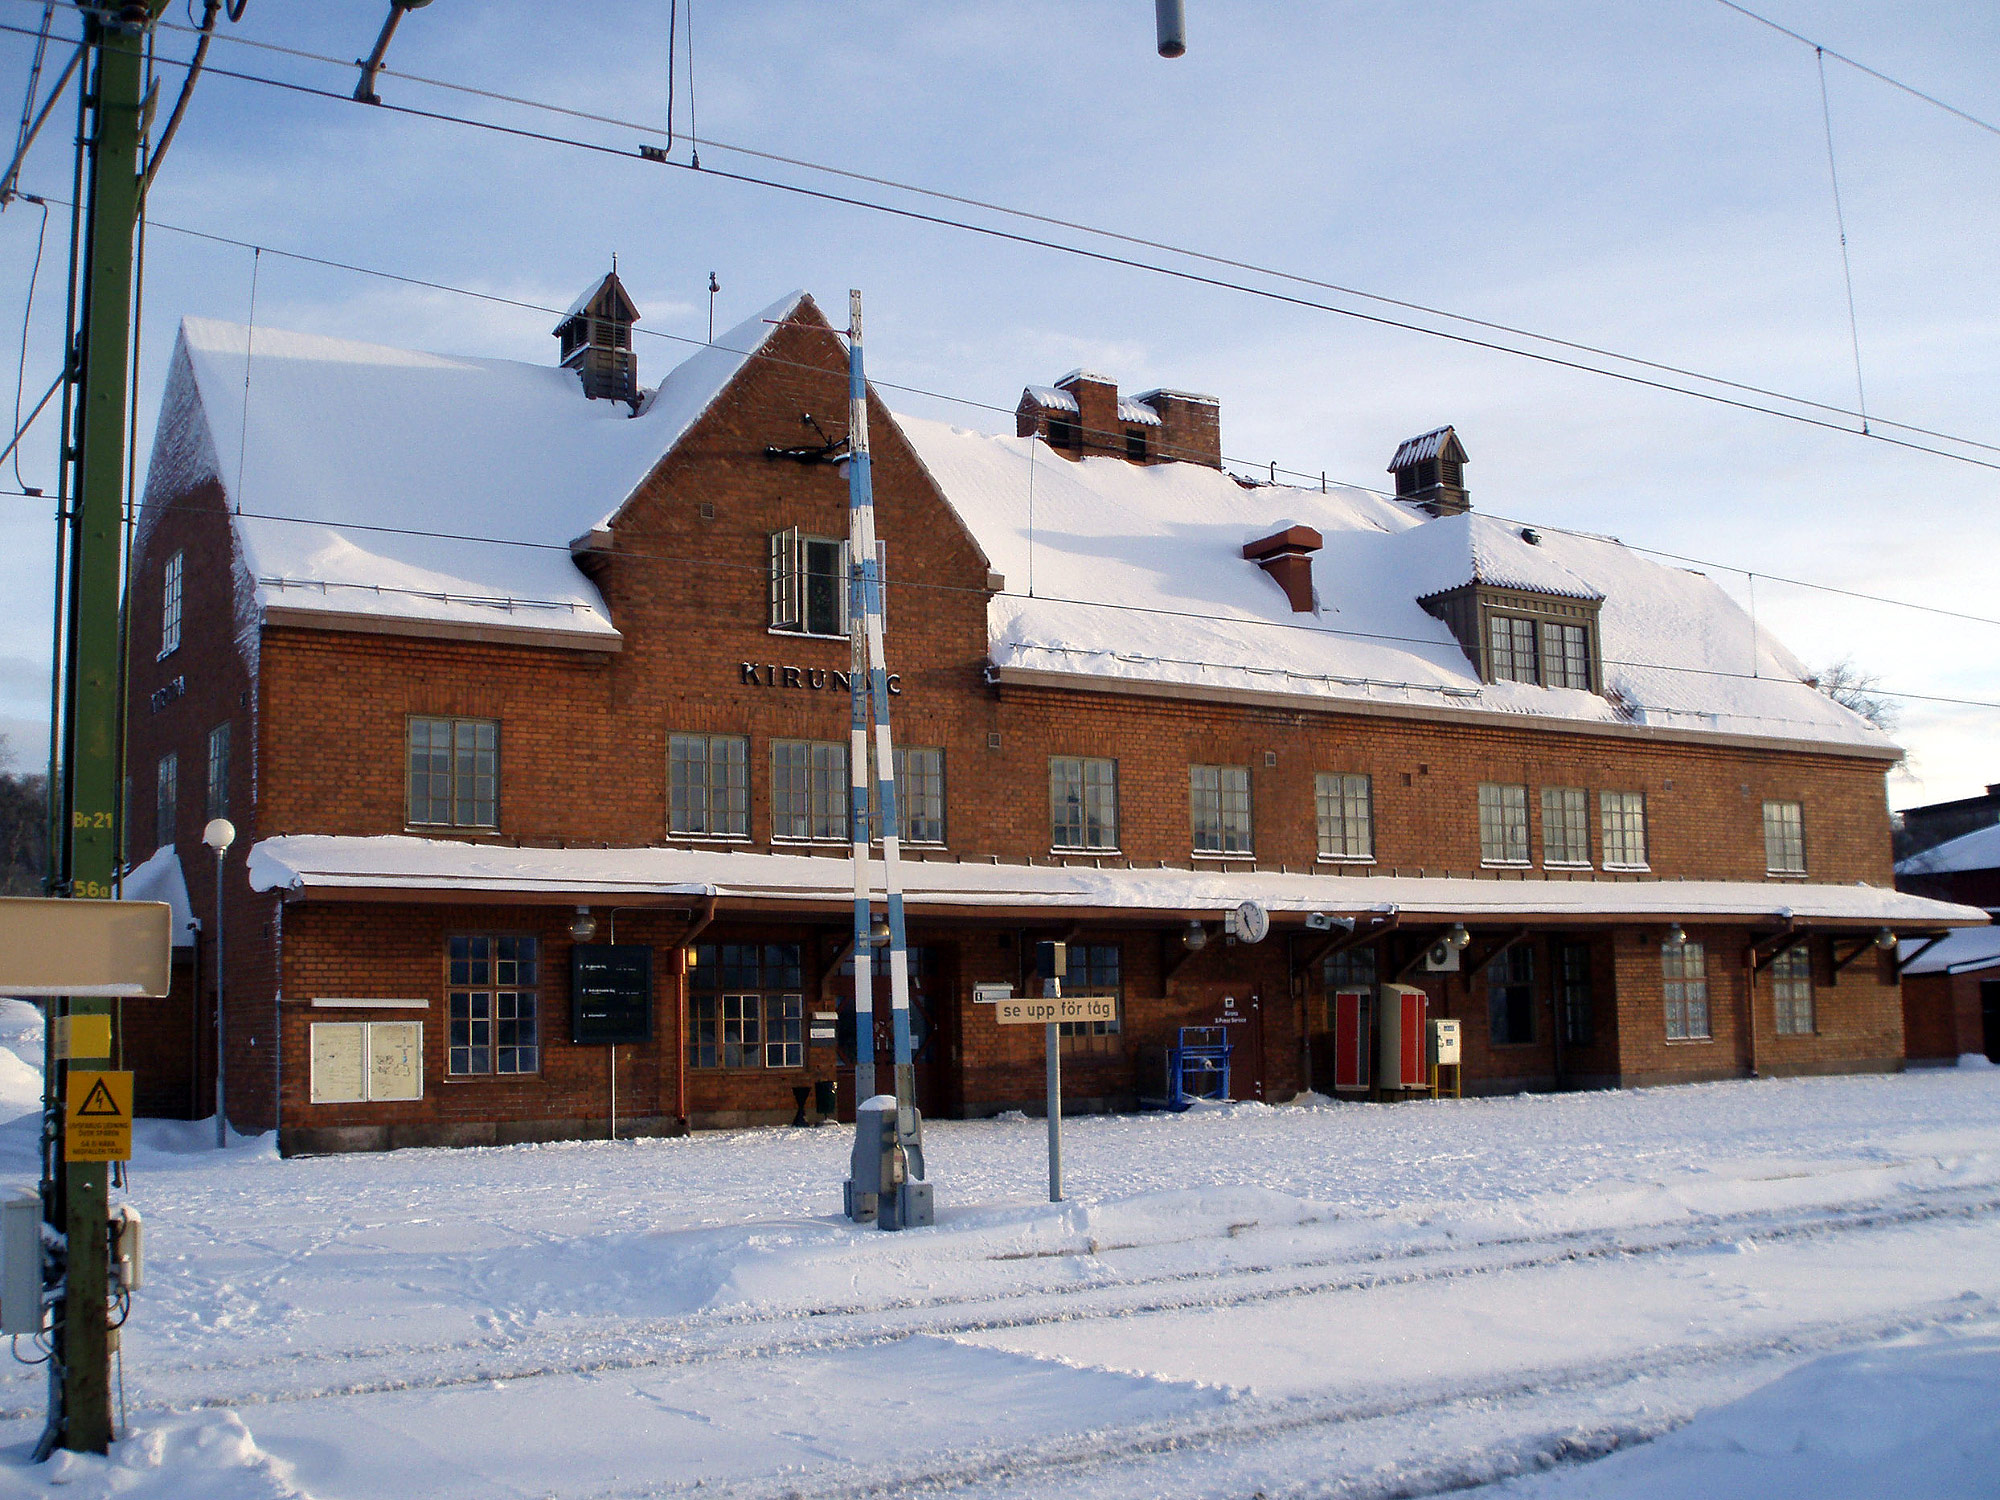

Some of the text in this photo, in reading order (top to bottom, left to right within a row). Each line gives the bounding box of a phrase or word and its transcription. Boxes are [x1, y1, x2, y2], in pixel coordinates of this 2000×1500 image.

[740, 661, 901, 695] KIRUN C
[73, 811, 113, 829] Br 21
[1003, 1001, 1111, 1020] se upp för tåg
